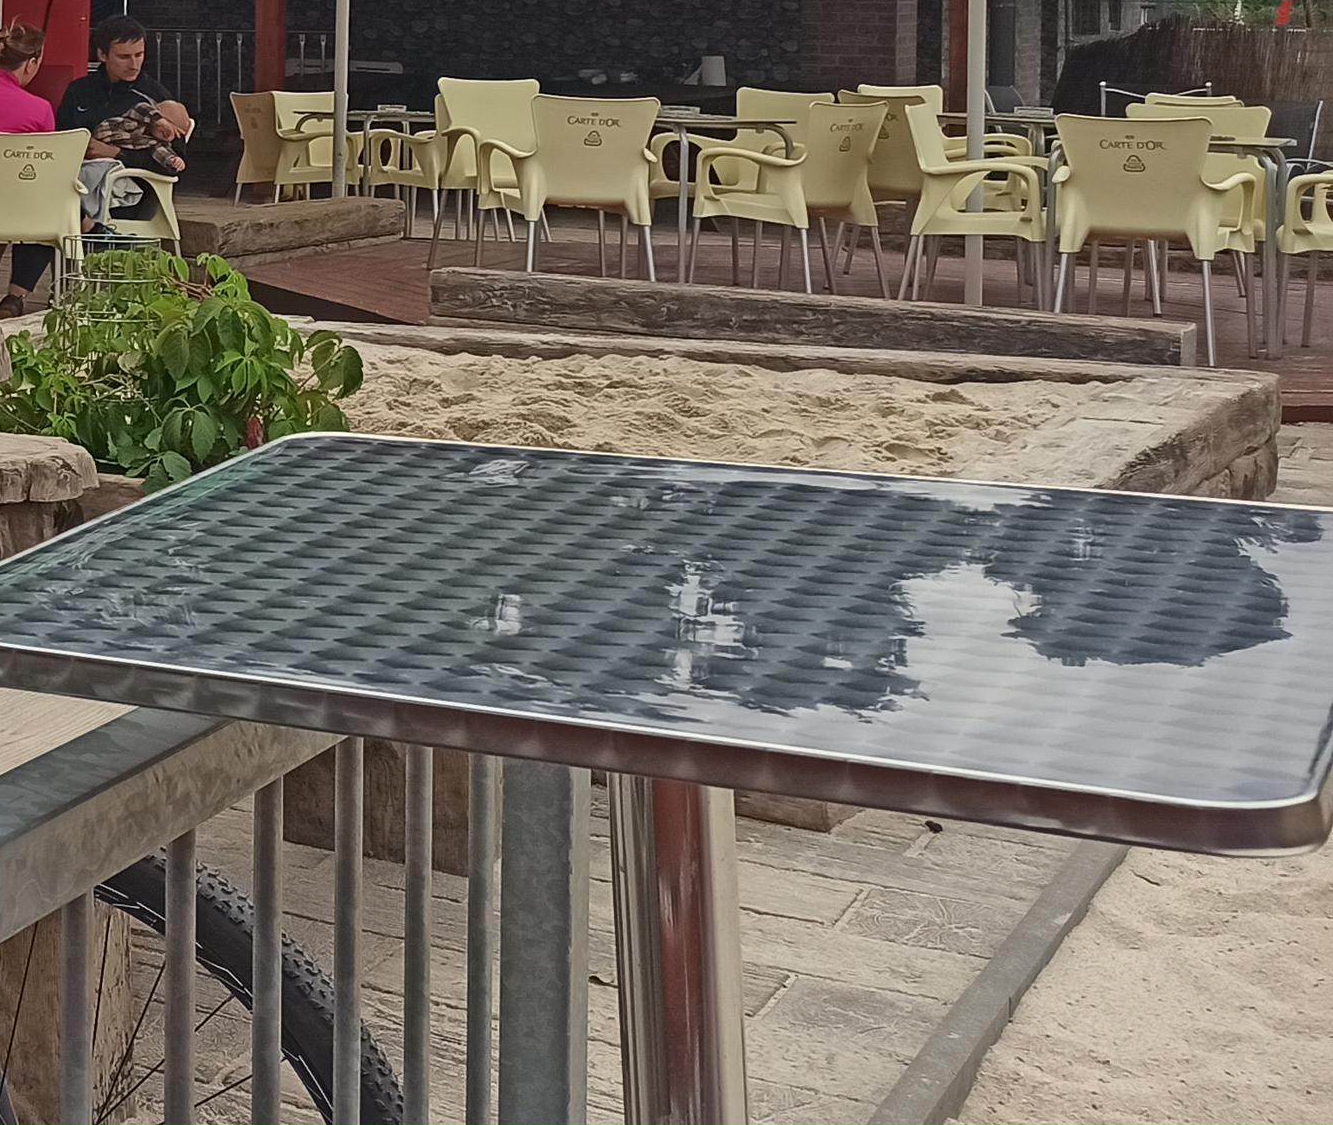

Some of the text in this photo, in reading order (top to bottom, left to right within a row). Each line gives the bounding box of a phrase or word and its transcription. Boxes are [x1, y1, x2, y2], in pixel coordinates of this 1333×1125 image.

[567, 115, 597, 127] CARTE
[1099, 139, 1166, 150] CARTE D'OR
[3, 148, 30, 159] CARTE
